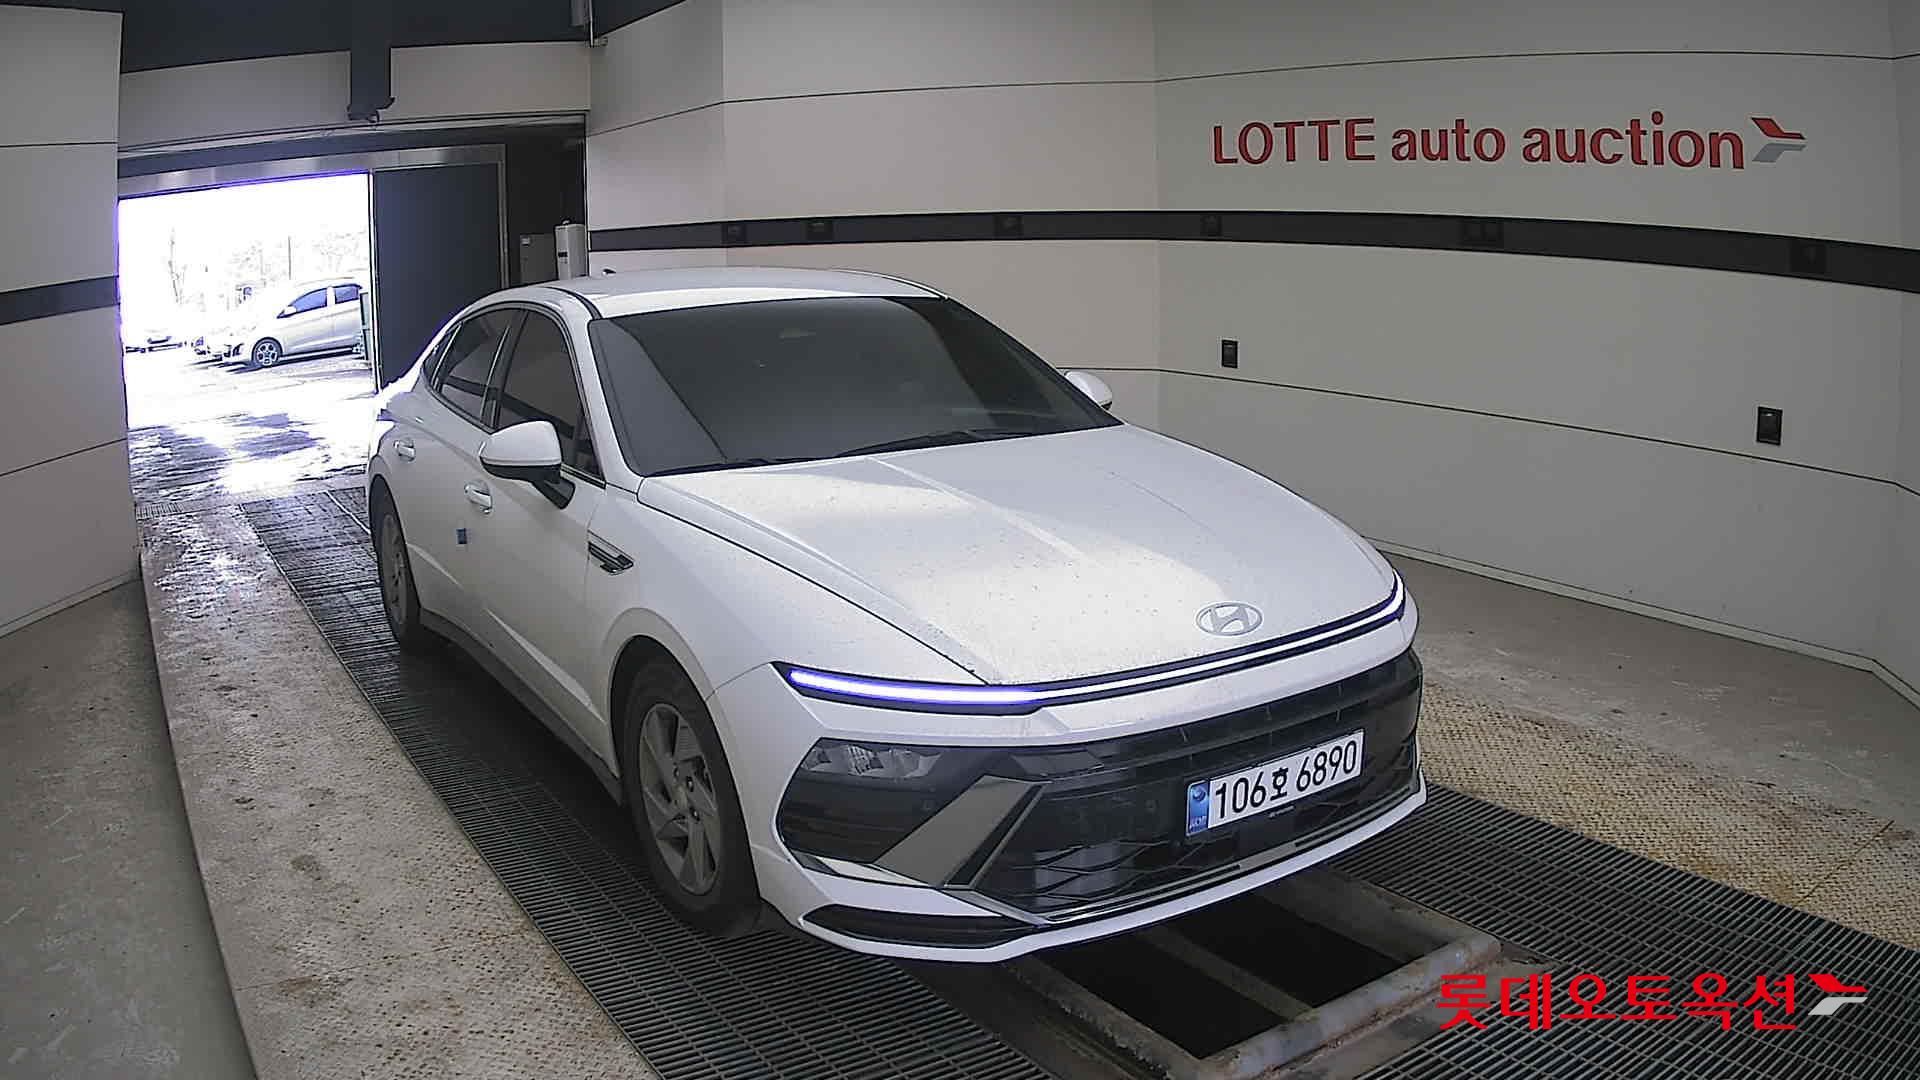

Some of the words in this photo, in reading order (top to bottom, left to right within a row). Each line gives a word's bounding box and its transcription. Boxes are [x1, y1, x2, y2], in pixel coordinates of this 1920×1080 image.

[1212, 117, 1376, 164] LOTTE
[1392, 118, 1506, 162] auto
[1522, 110, 1745, 169] auction
[1215, 767, 1289, 819] 106호
[1296, 740, 1357, 792] 6890
